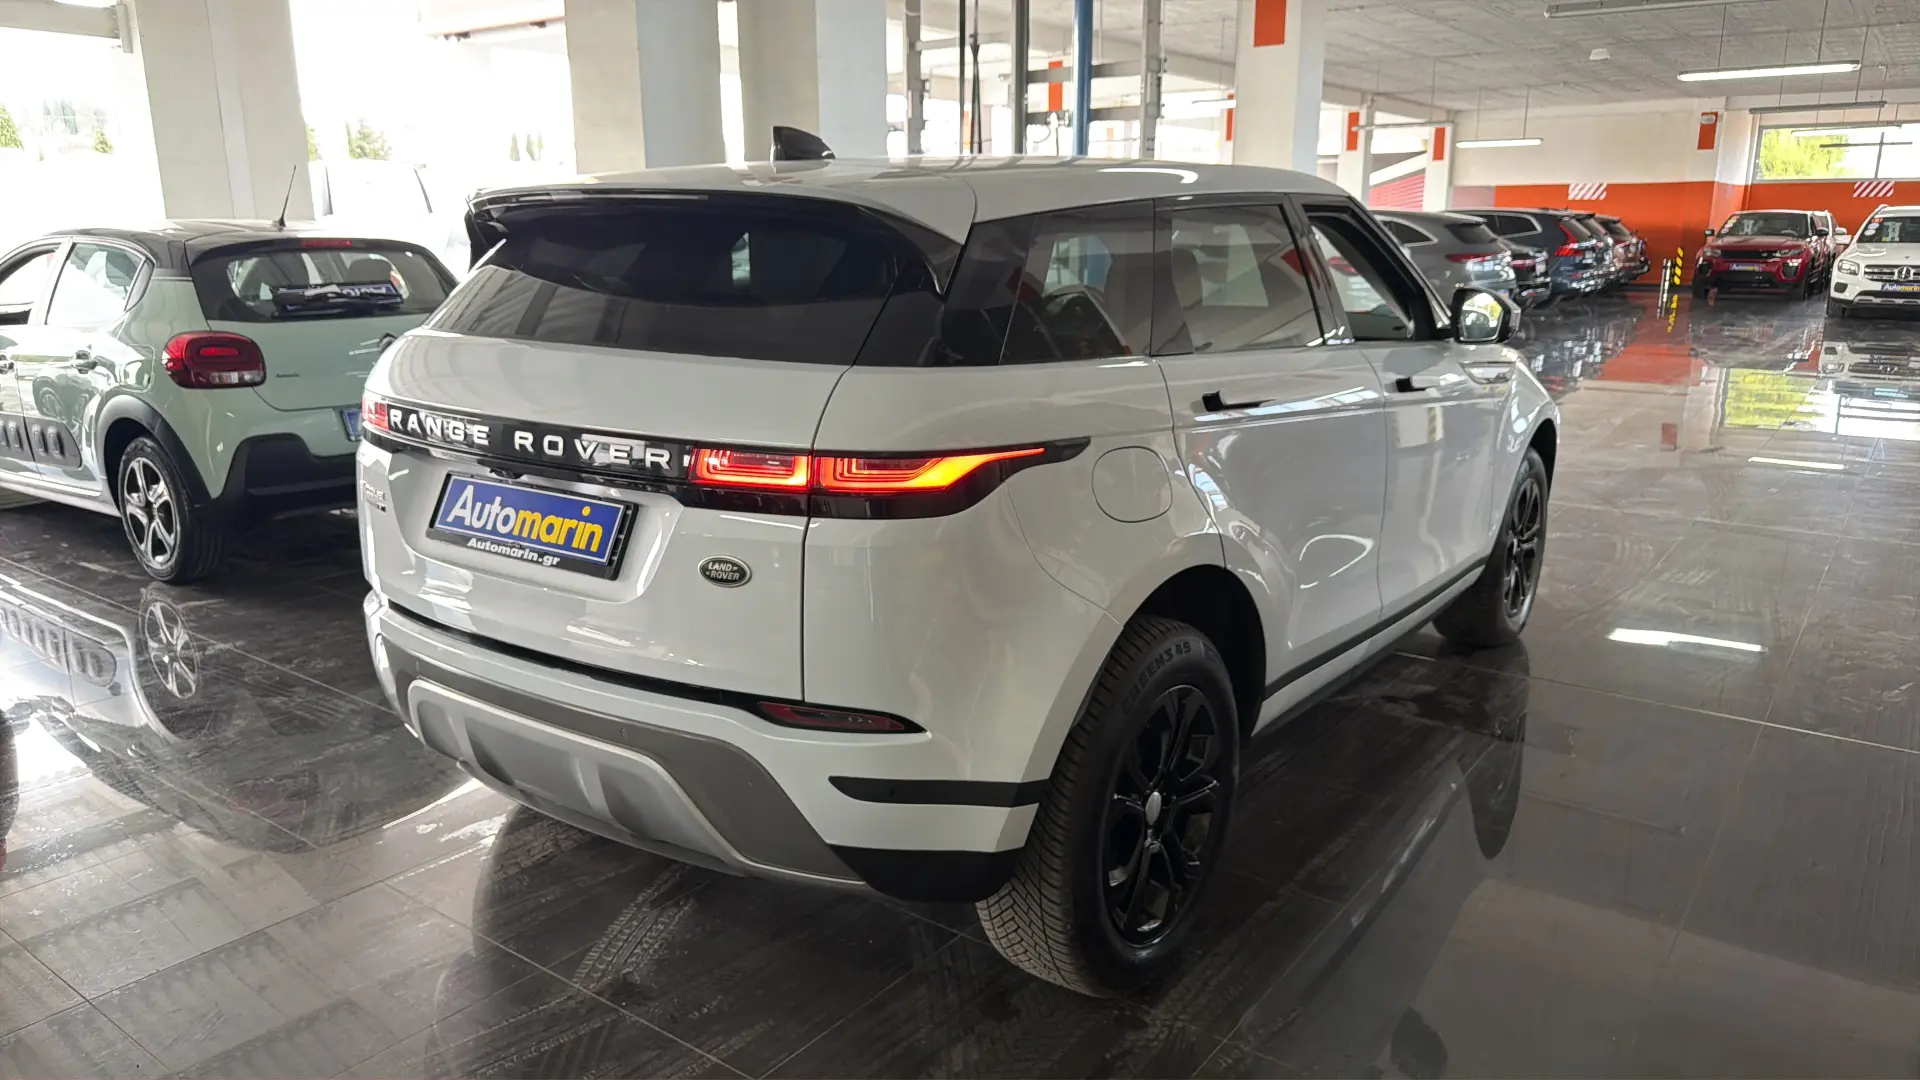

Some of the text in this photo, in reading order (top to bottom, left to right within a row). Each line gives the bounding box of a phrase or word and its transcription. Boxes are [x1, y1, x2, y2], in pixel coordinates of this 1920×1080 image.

[389, 408, 672, 470] RANGE ROVER
[446, 484, 603, 553] Automarin
[466, 537, 560, 567] Automarin.gr
[708, 561, 732, 572] LAND
[710, 570, 740, 581] ROVER
